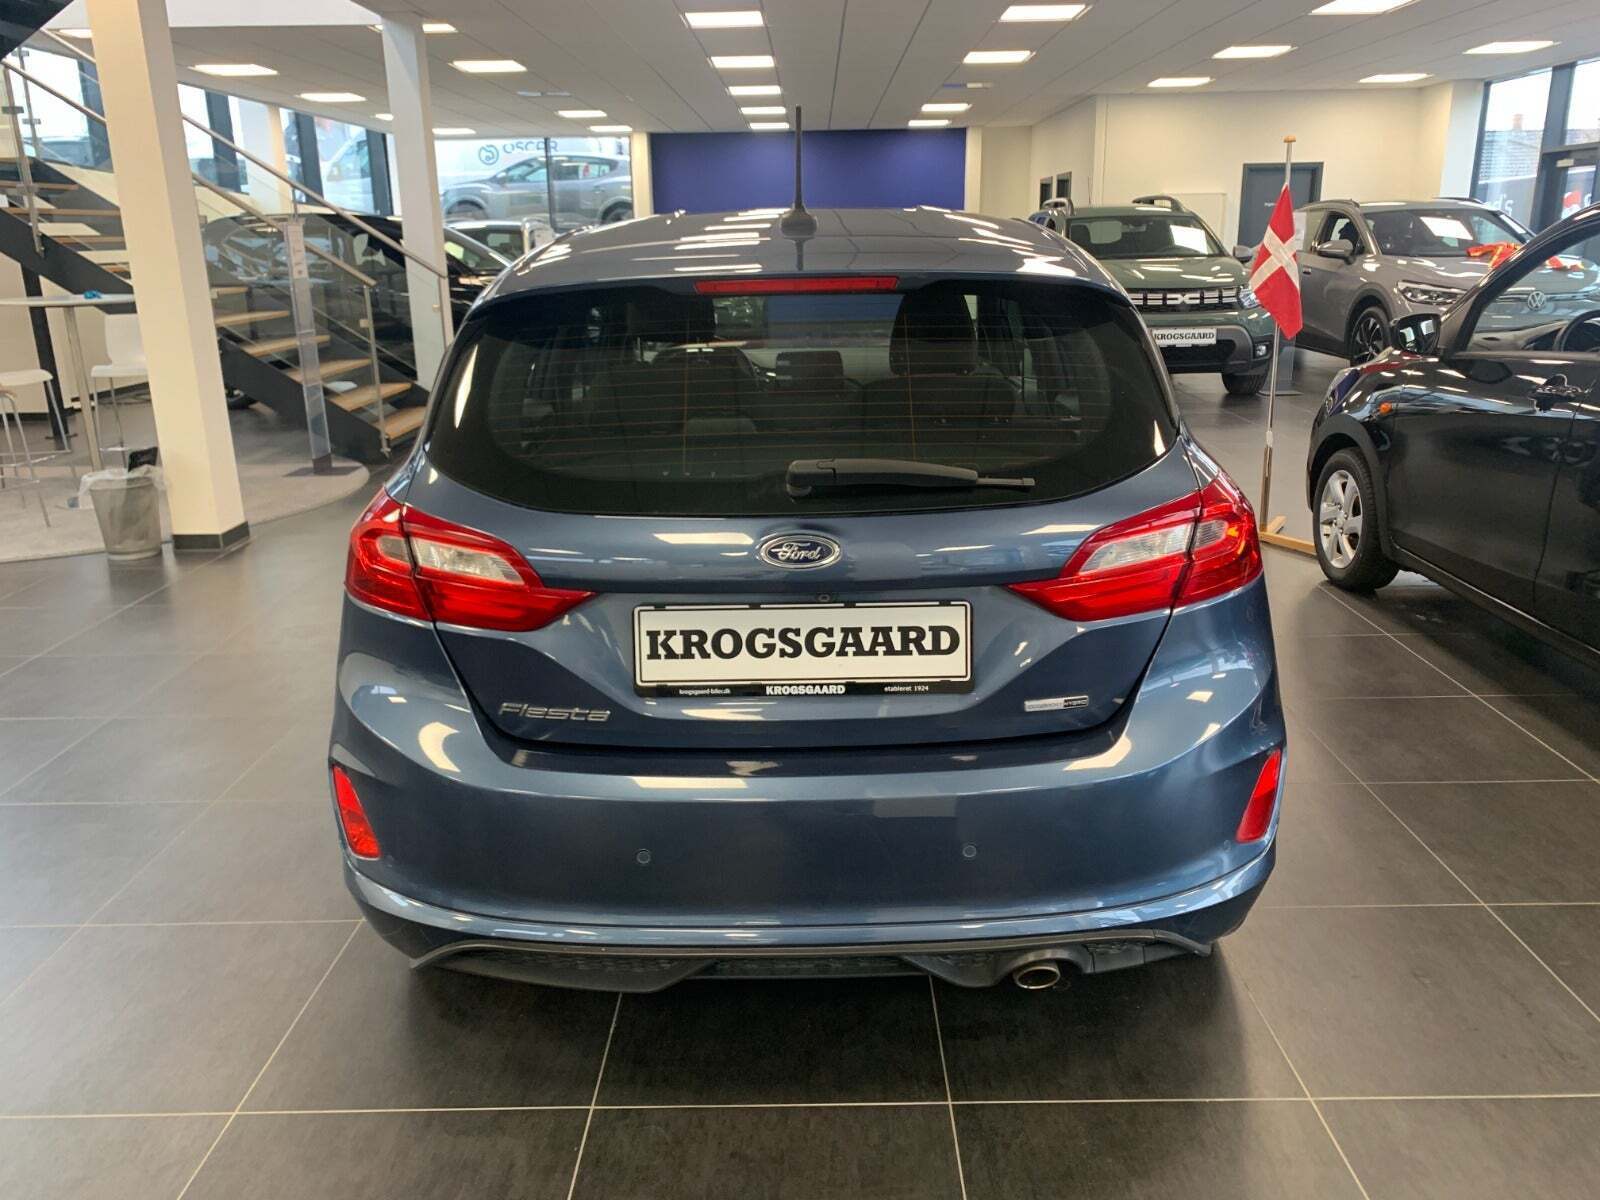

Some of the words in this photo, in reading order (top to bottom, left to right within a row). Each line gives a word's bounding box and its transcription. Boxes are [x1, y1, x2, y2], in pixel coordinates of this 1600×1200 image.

[1154, 332, 1215, 340] KROGSGAARD
[770, 542, 822, 561] Ford
[646, 625, 961, 660] KROGSGAARD
[765, 684, 846, 696] KROGSGAARD
[499, 702, 611, 721] Fiesta
